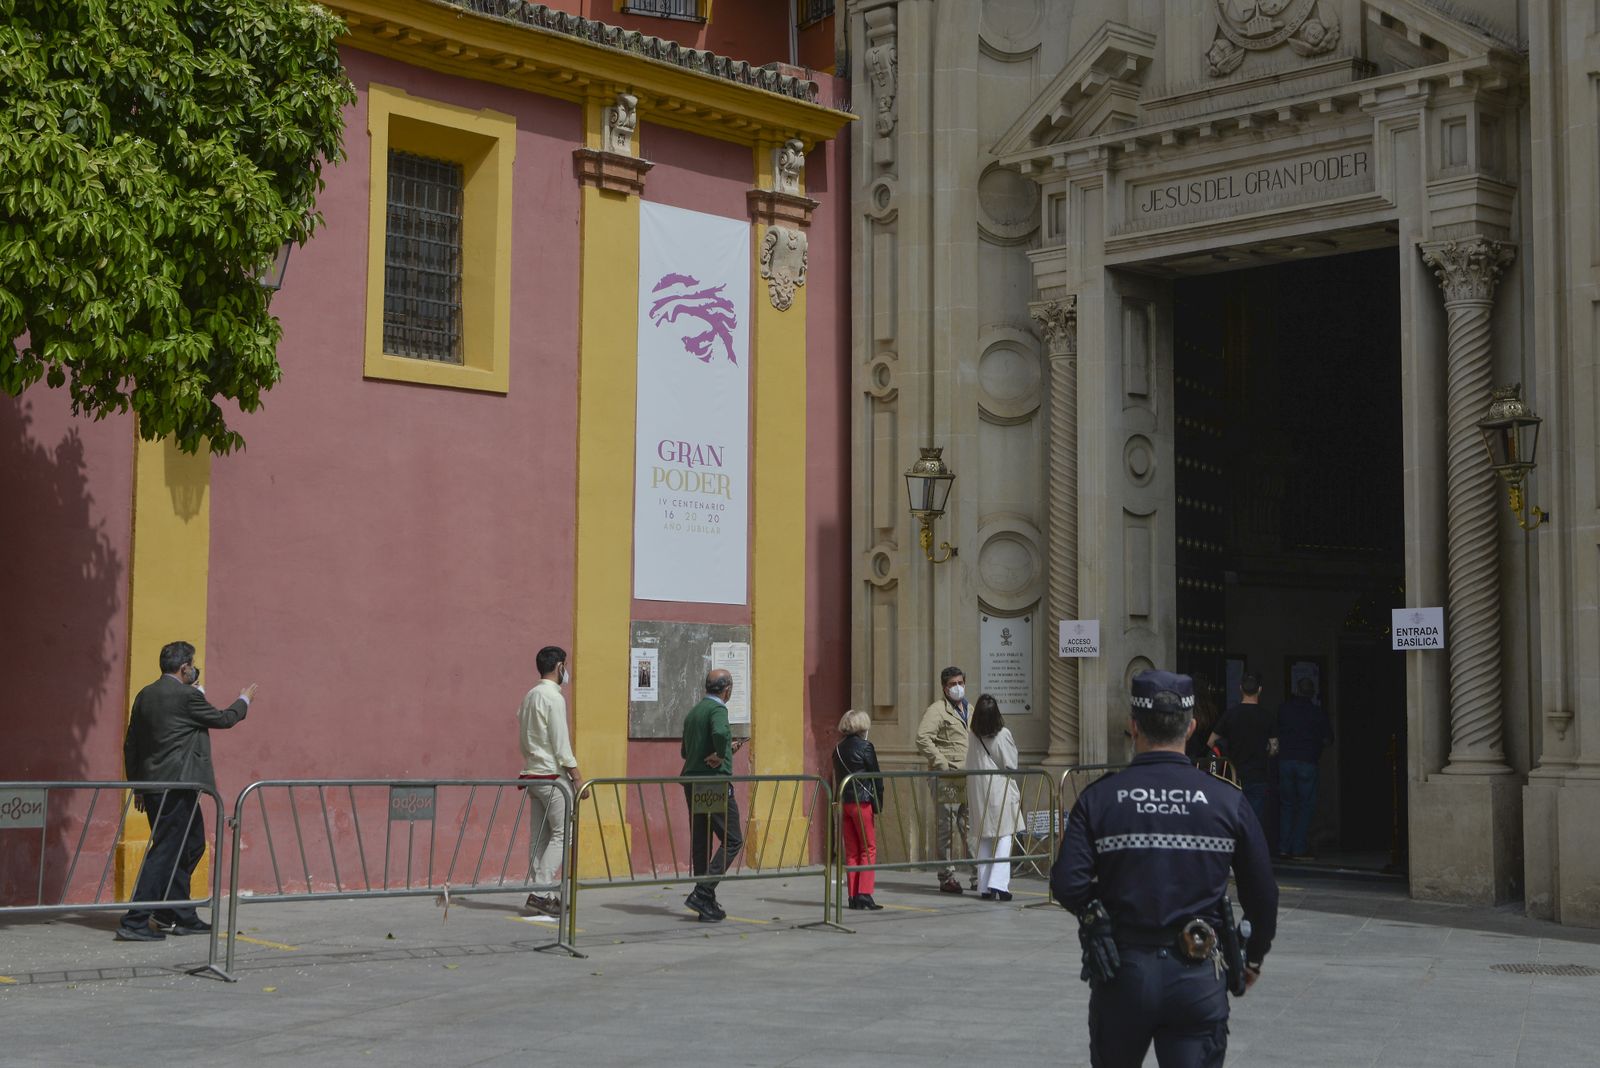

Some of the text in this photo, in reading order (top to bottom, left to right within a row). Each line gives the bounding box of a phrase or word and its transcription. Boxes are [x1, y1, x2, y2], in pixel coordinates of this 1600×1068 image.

[1141, 151, 1368, 213] JESUS DEL GRAN PODER
[657, 439, 725, 468] GRAN
[650, 466, 732, 500] PODER
[672, 499, 726, 511] CENTENARIO
[664, 509, 720, 523] 16 20 20
[686, 524, 721, 535] JUBILAR
[1396, 626, 1439, 637] ENTRADA
[1397, 636, 1438, 647] BASÍLICA
[1061, 645, 1097, 653] VENERACIÓN
[1117, 788, 1208, 804] POLICIA
[1136, 803, 1189, 815] LOCAL
